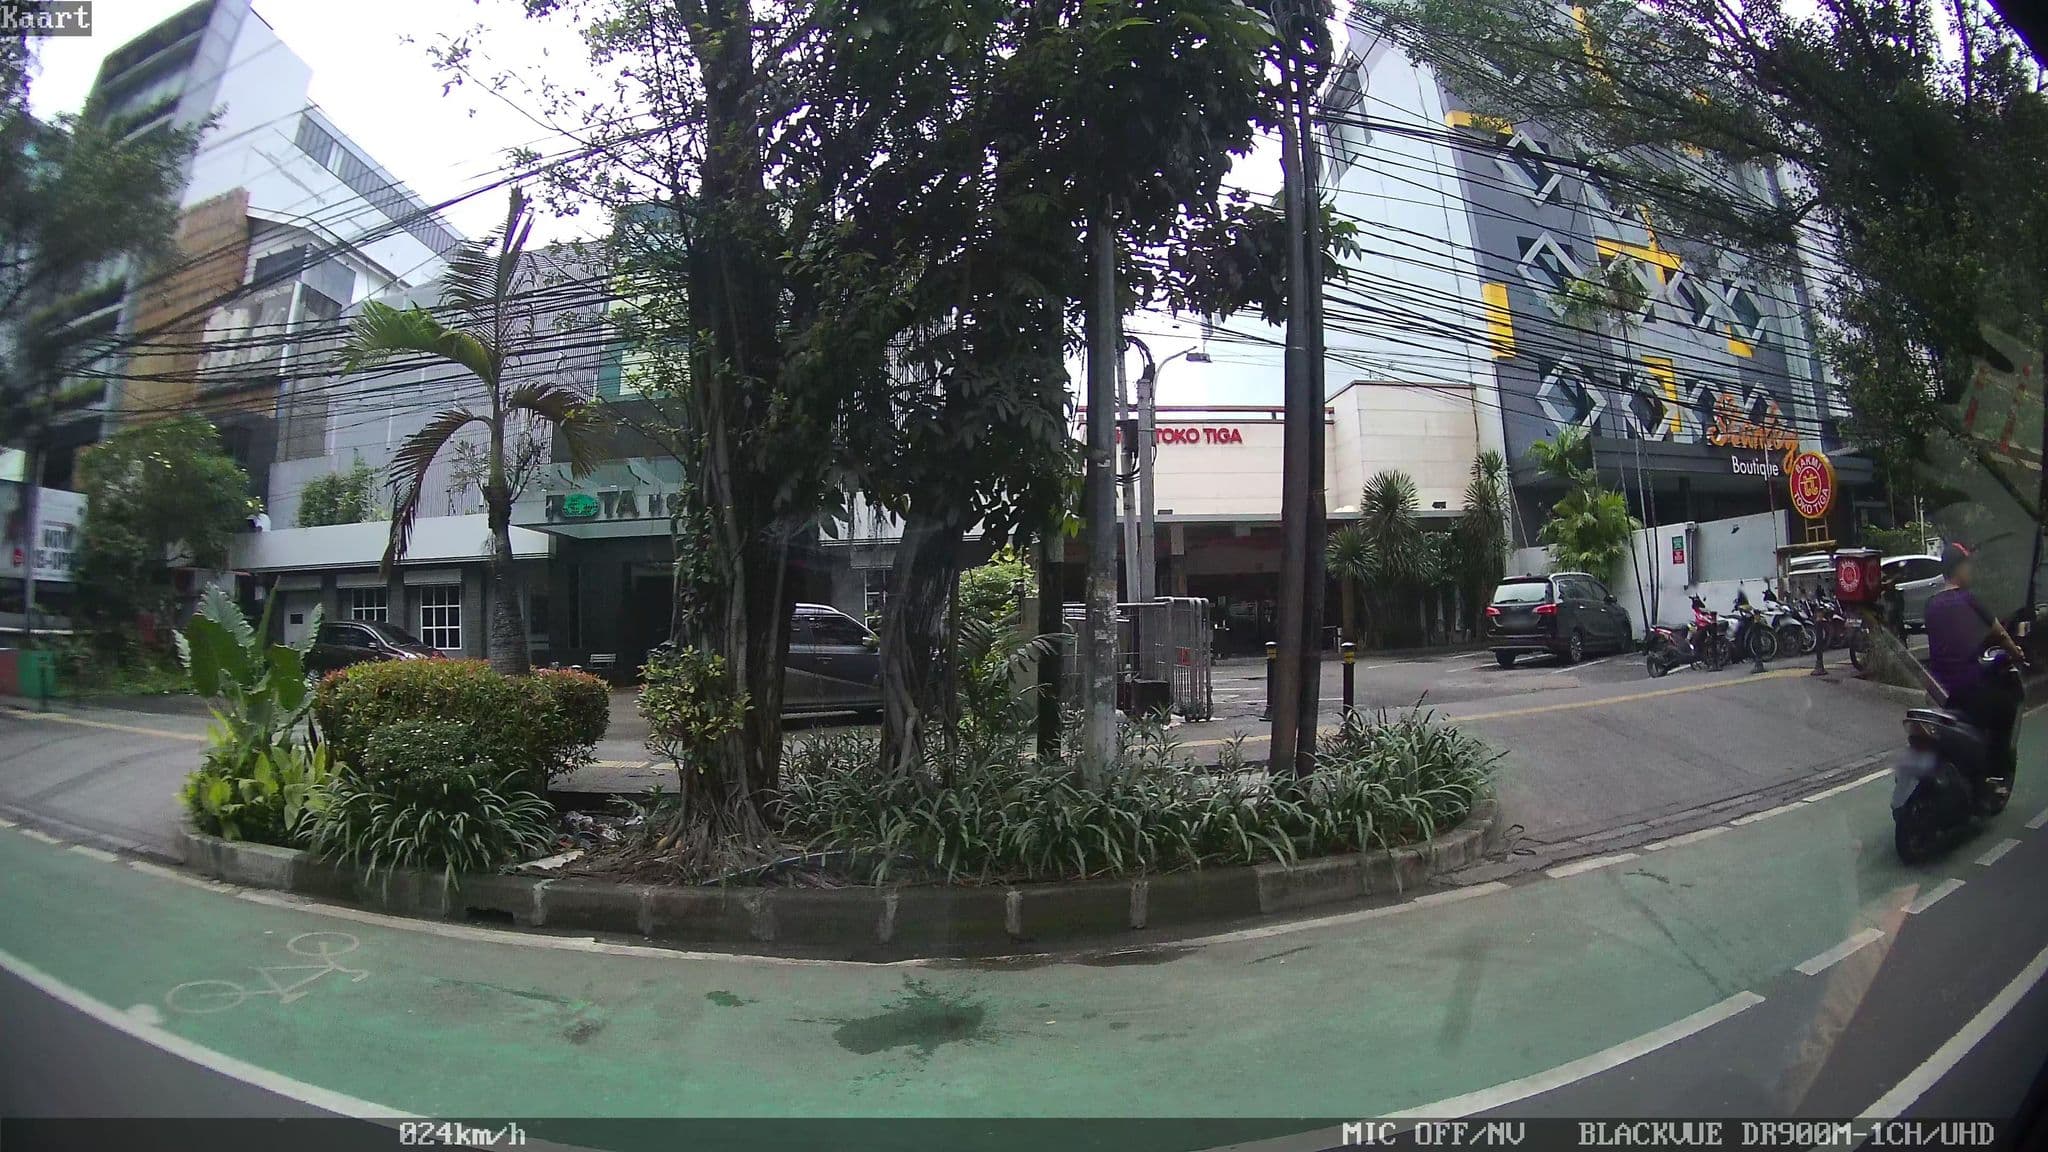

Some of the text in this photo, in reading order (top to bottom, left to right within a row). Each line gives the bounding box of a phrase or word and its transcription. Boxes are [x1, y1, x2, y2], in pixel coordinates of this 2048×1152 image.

[1154, 427, 1243, 445] TOKO TIGA
[1731, 455, 1780, 481] Boutique
[1795, 456, 1822, 474] BAKMI
[1794, 488, 1830, 514] TOKO TIGA
